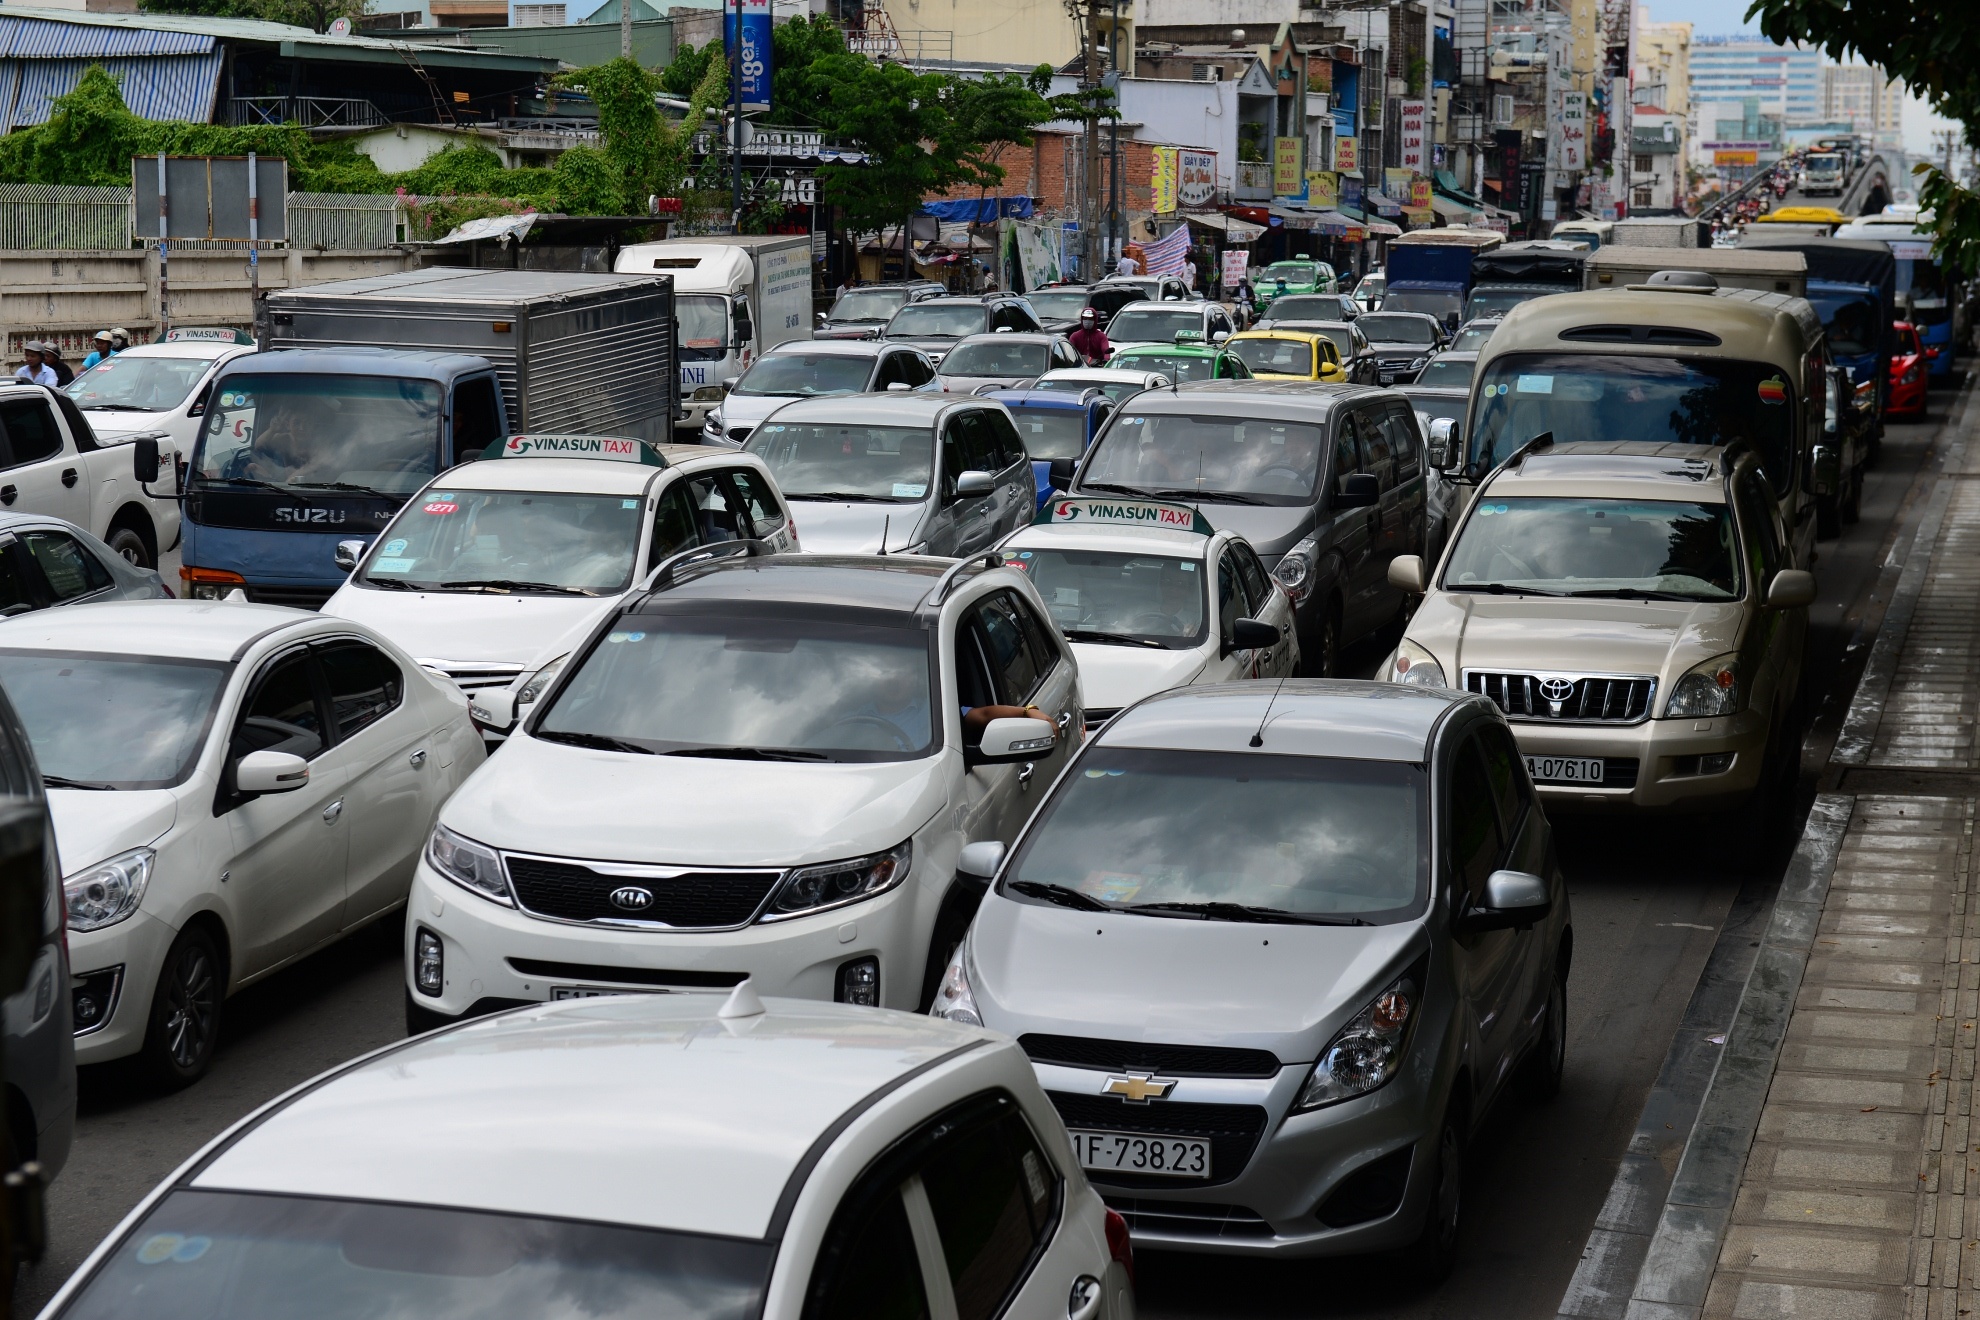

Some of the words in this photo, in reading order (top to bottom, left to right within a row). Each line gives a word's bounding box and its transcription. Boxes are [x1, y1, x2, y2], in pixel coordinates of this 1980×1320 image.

[1403, 106, 1424, 116] SHOP
[1404, 121, 1421, 131] HOA
[1280, 140, 1296, 150] HOA
[1404, 138, 1420, 148] LAN
[1280, 155, 1295, 165] LAN
[1505, 148, 1518, 200] HOTEL
[1277, 183, 1297, 192] MINH
[1520, 173, 1530, 208] HOTEL
[424, 504, 455, 513] 4271
[616, 891, 646, 906] KIA
